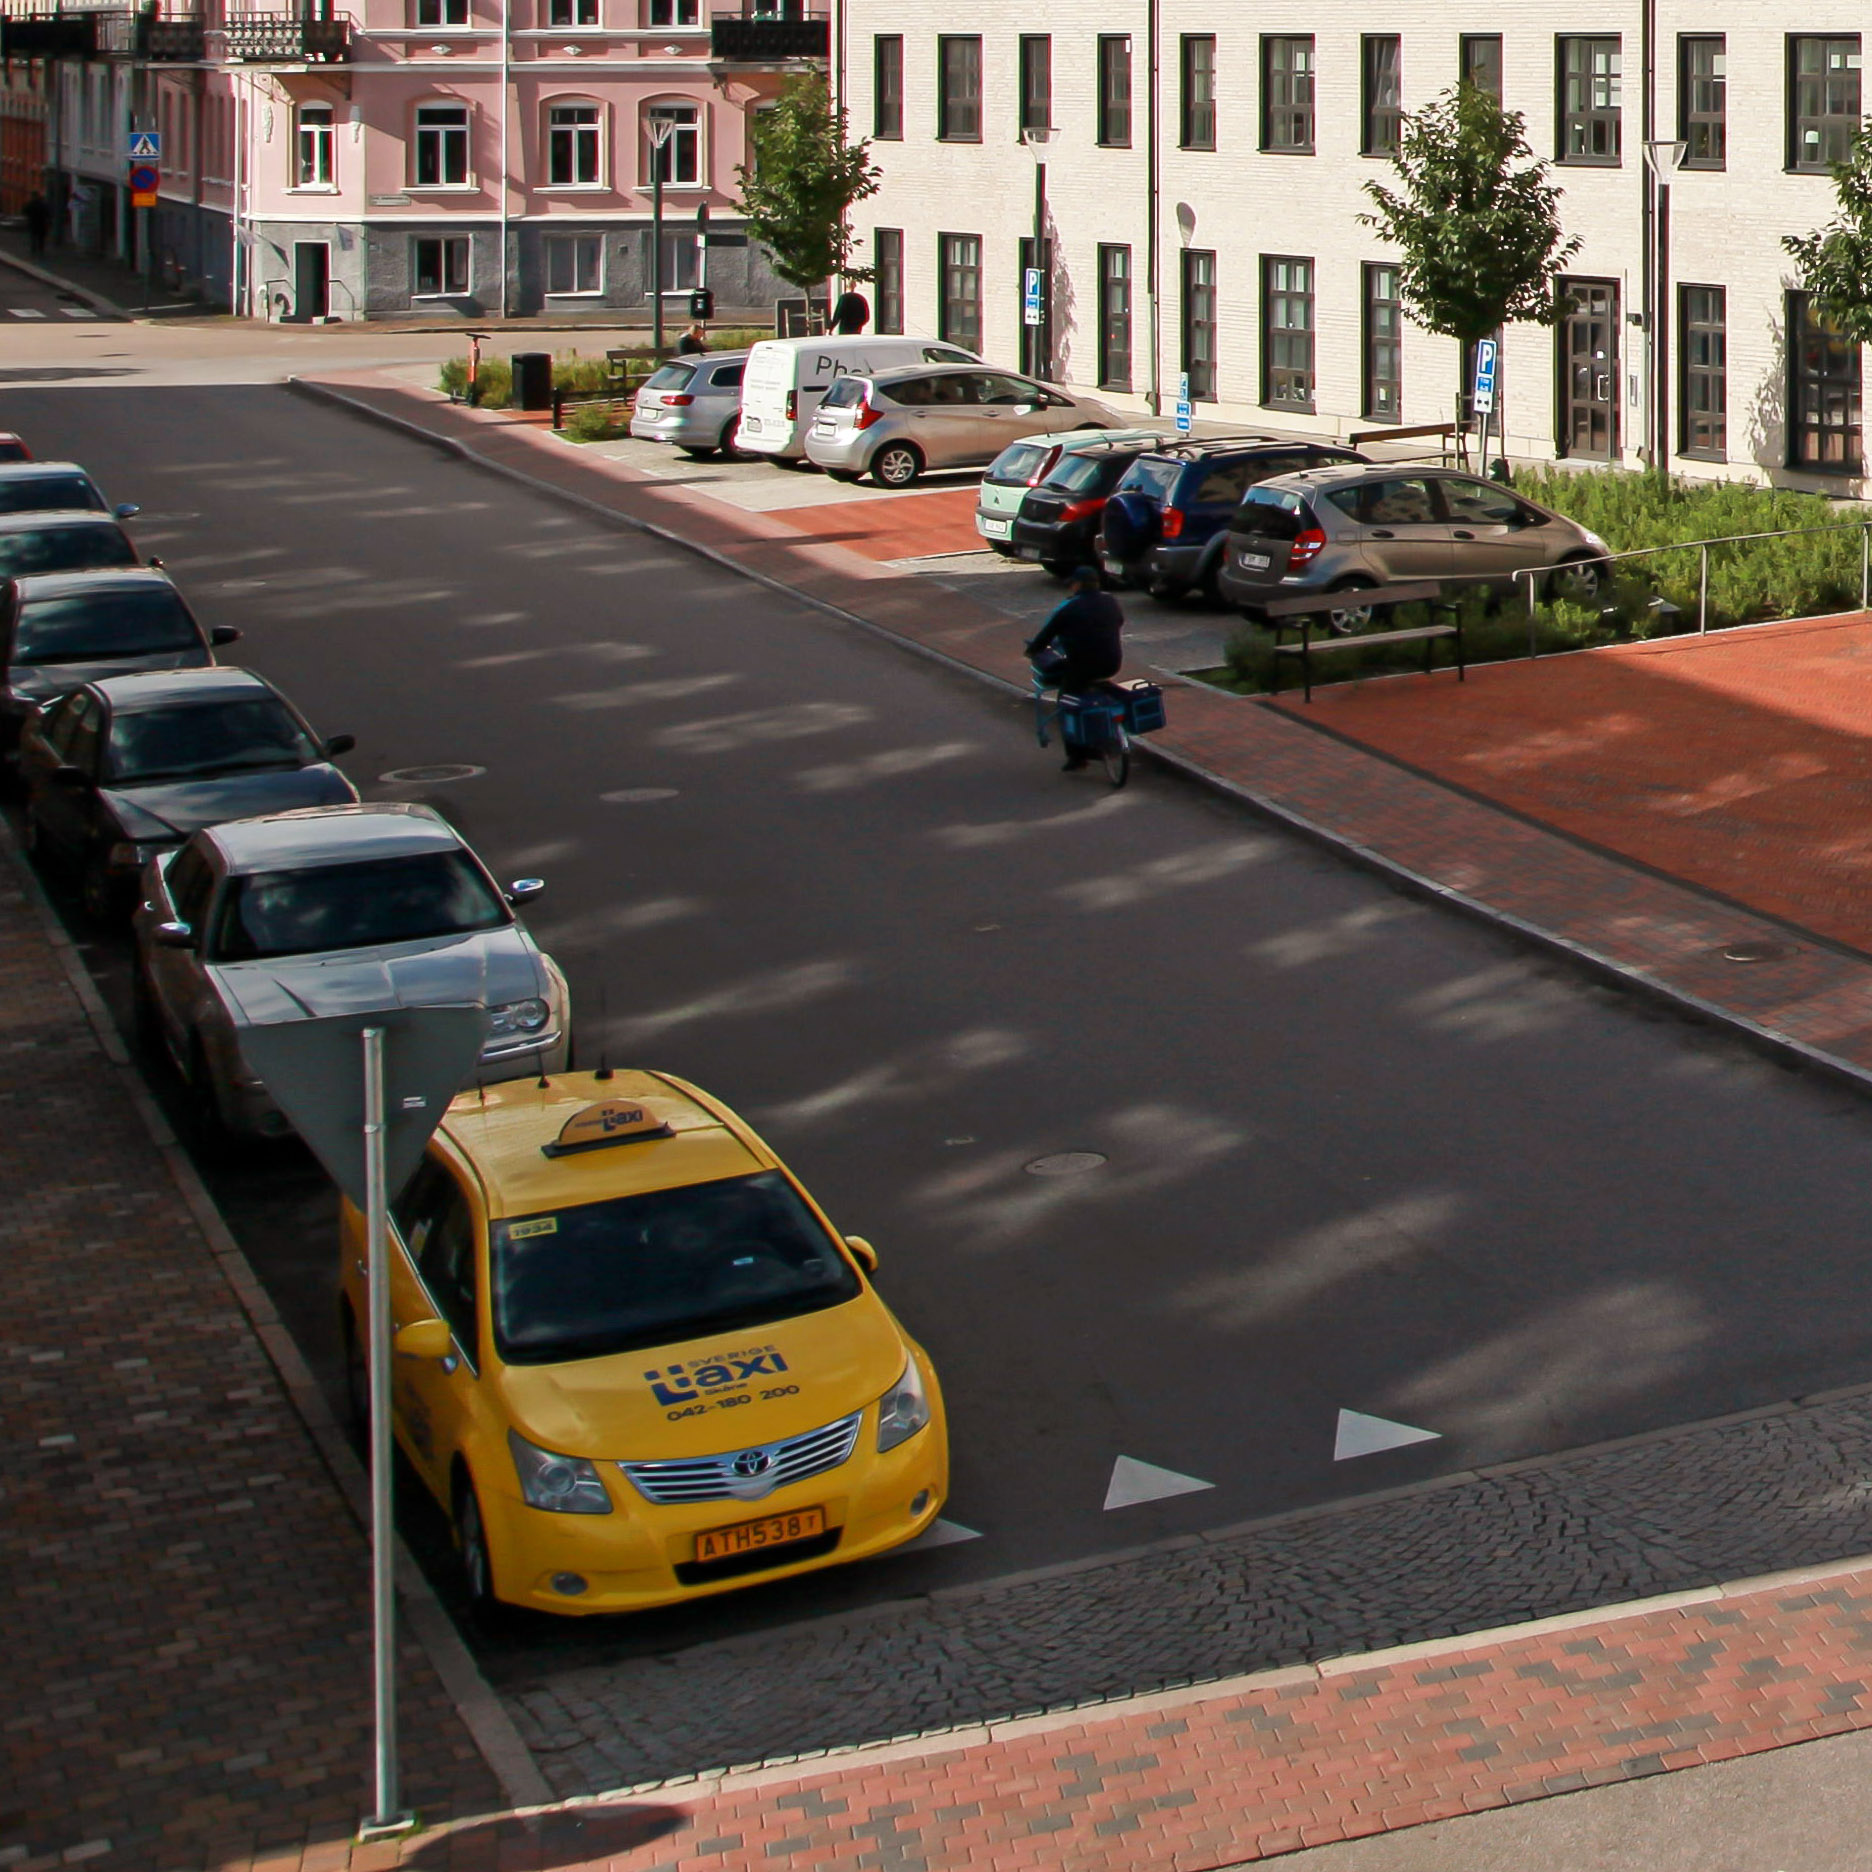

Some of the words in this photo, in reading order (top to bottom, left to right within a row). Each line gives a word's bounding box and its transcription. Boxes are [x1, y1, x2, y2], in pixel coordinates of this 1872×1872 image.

[1482, 344, 1493, 372] P
[687, 1345, 778, 1368] SVERIGE
[666, 1394, 752, 1422] 042-180
[759, 1384, 801, 1401] 200
